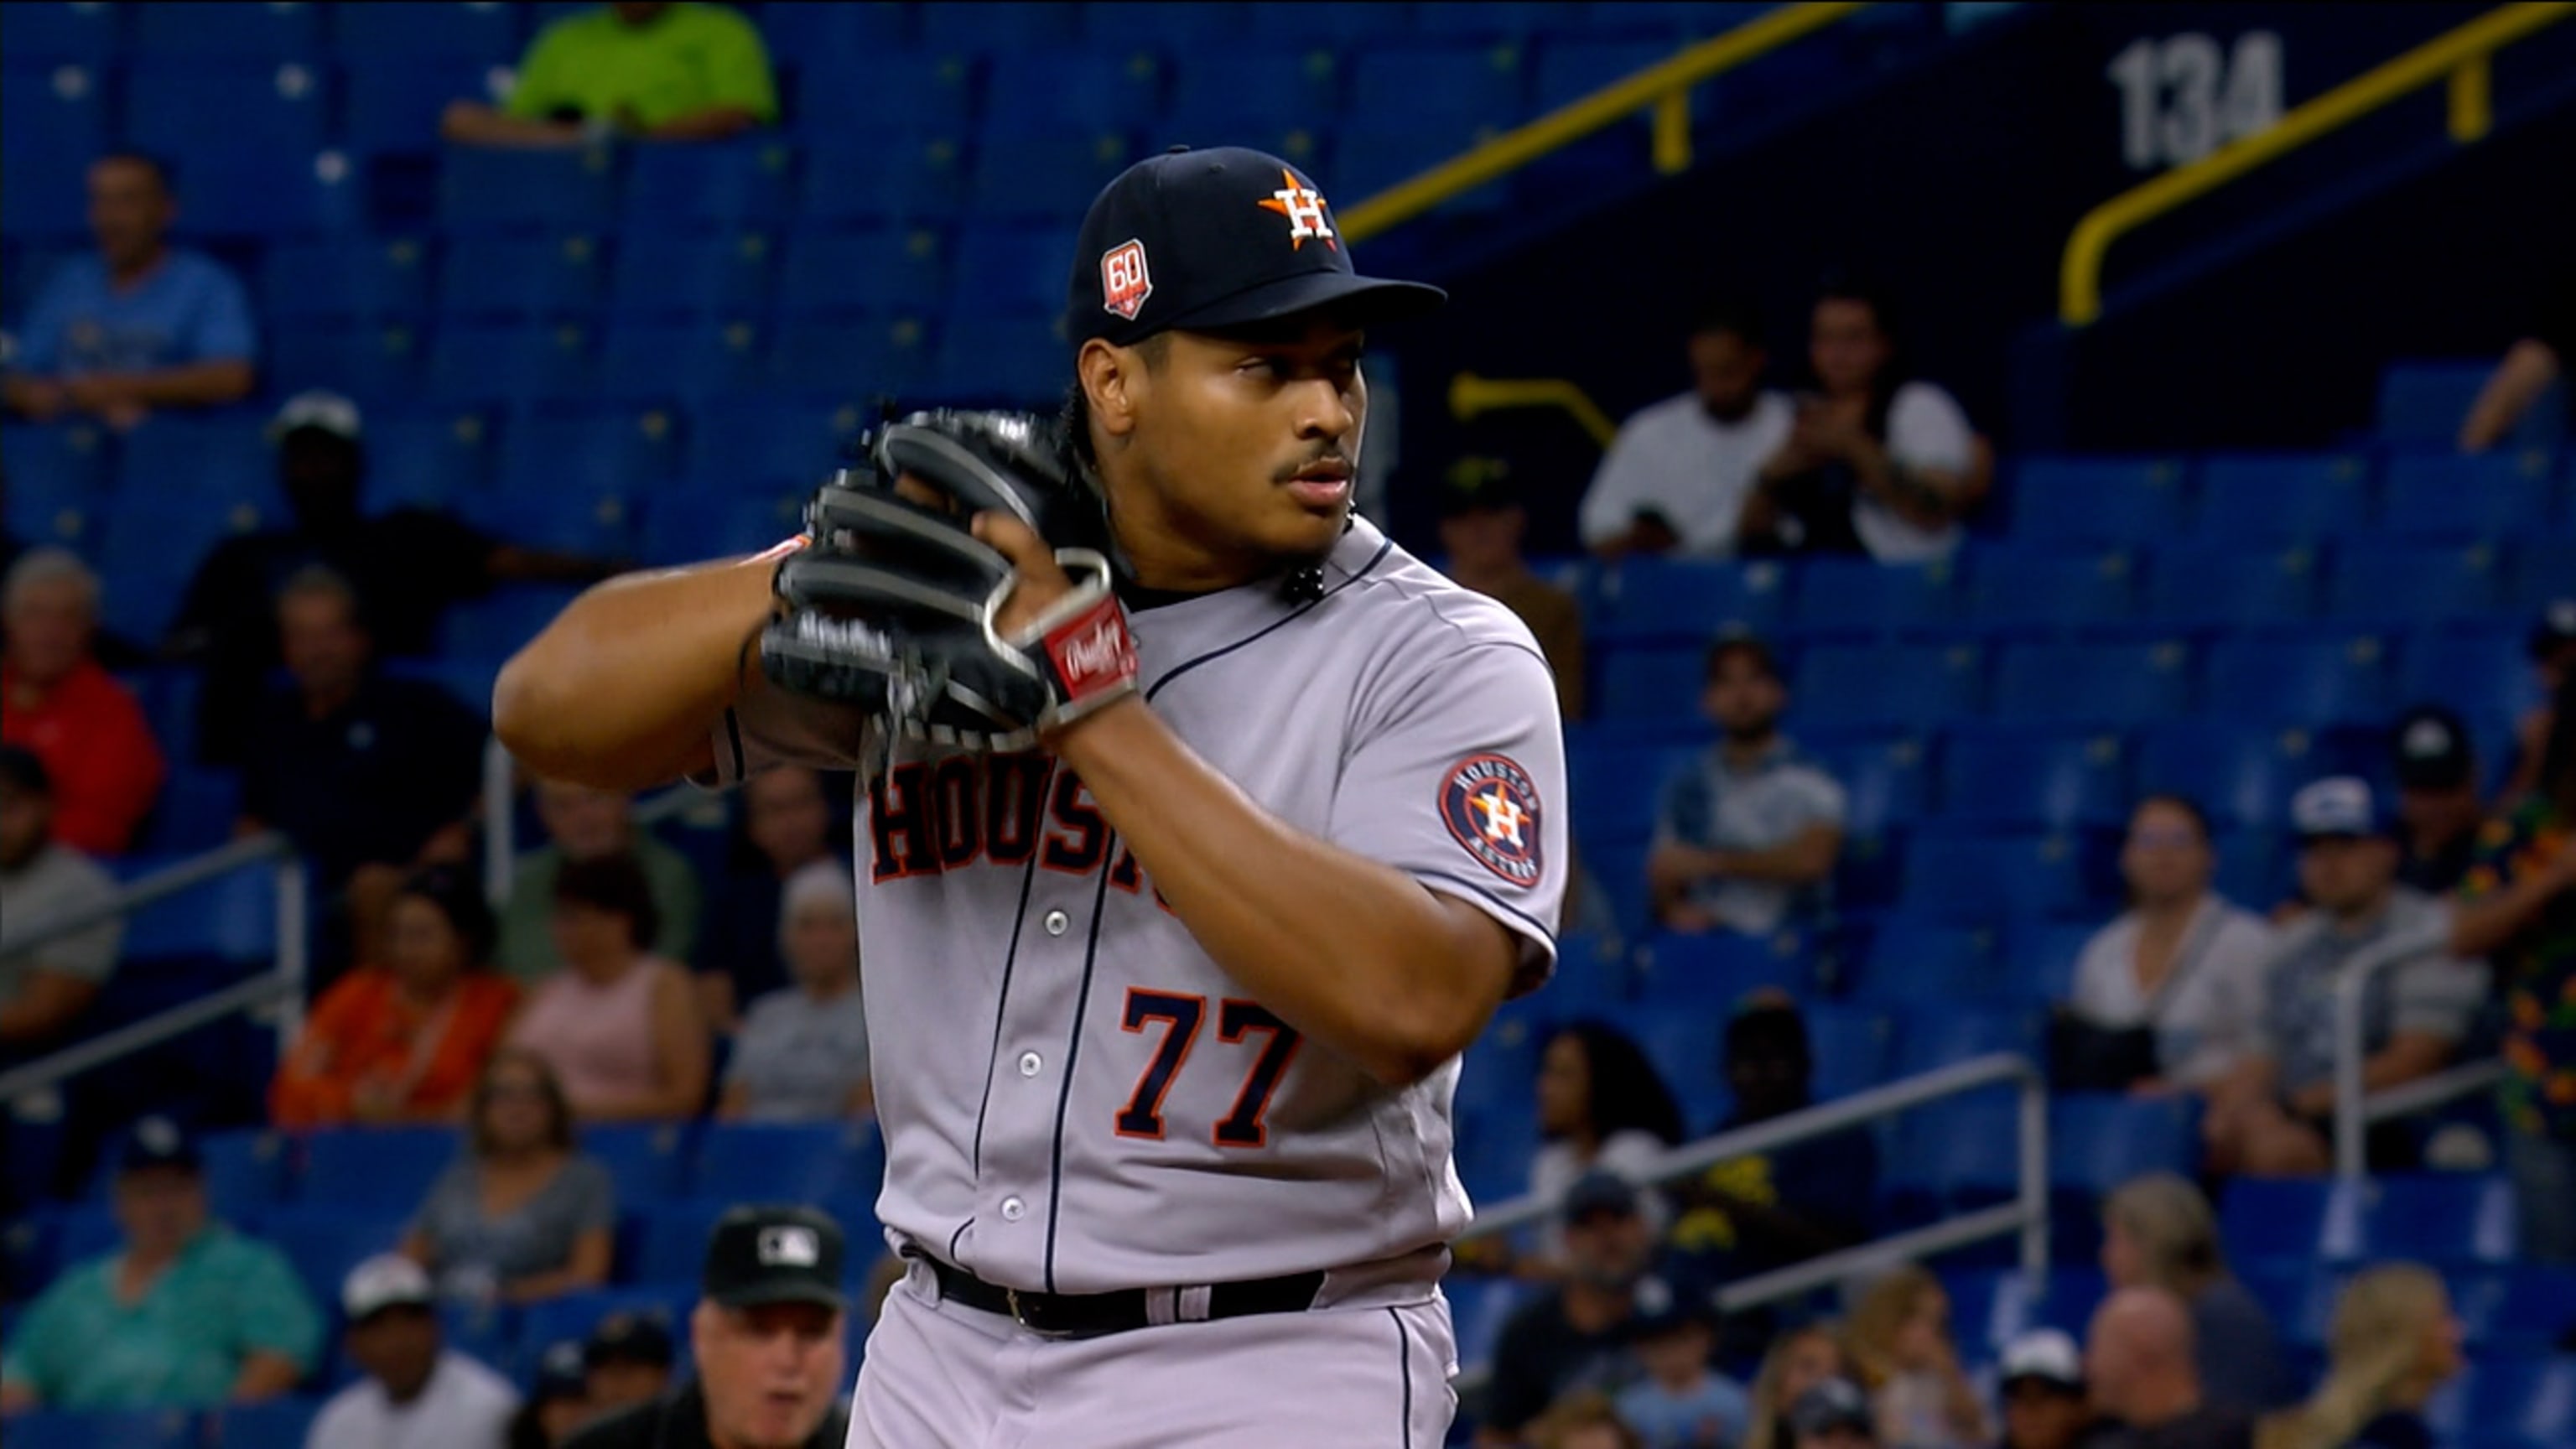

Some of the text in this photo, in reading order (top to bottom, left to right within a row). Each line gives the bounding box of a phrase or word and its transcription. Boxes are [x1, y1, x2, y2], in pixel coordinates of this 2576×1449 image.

[2106, 31, 2284, 170] 134
[1273, 188, 1334, 240] H
[1108, 248, 1142, 293] 60
[869, 753, 1177, 917] HOUS
[1479, 792, 1524, 849] H
[1114, 985, 1305, 1148] 77
